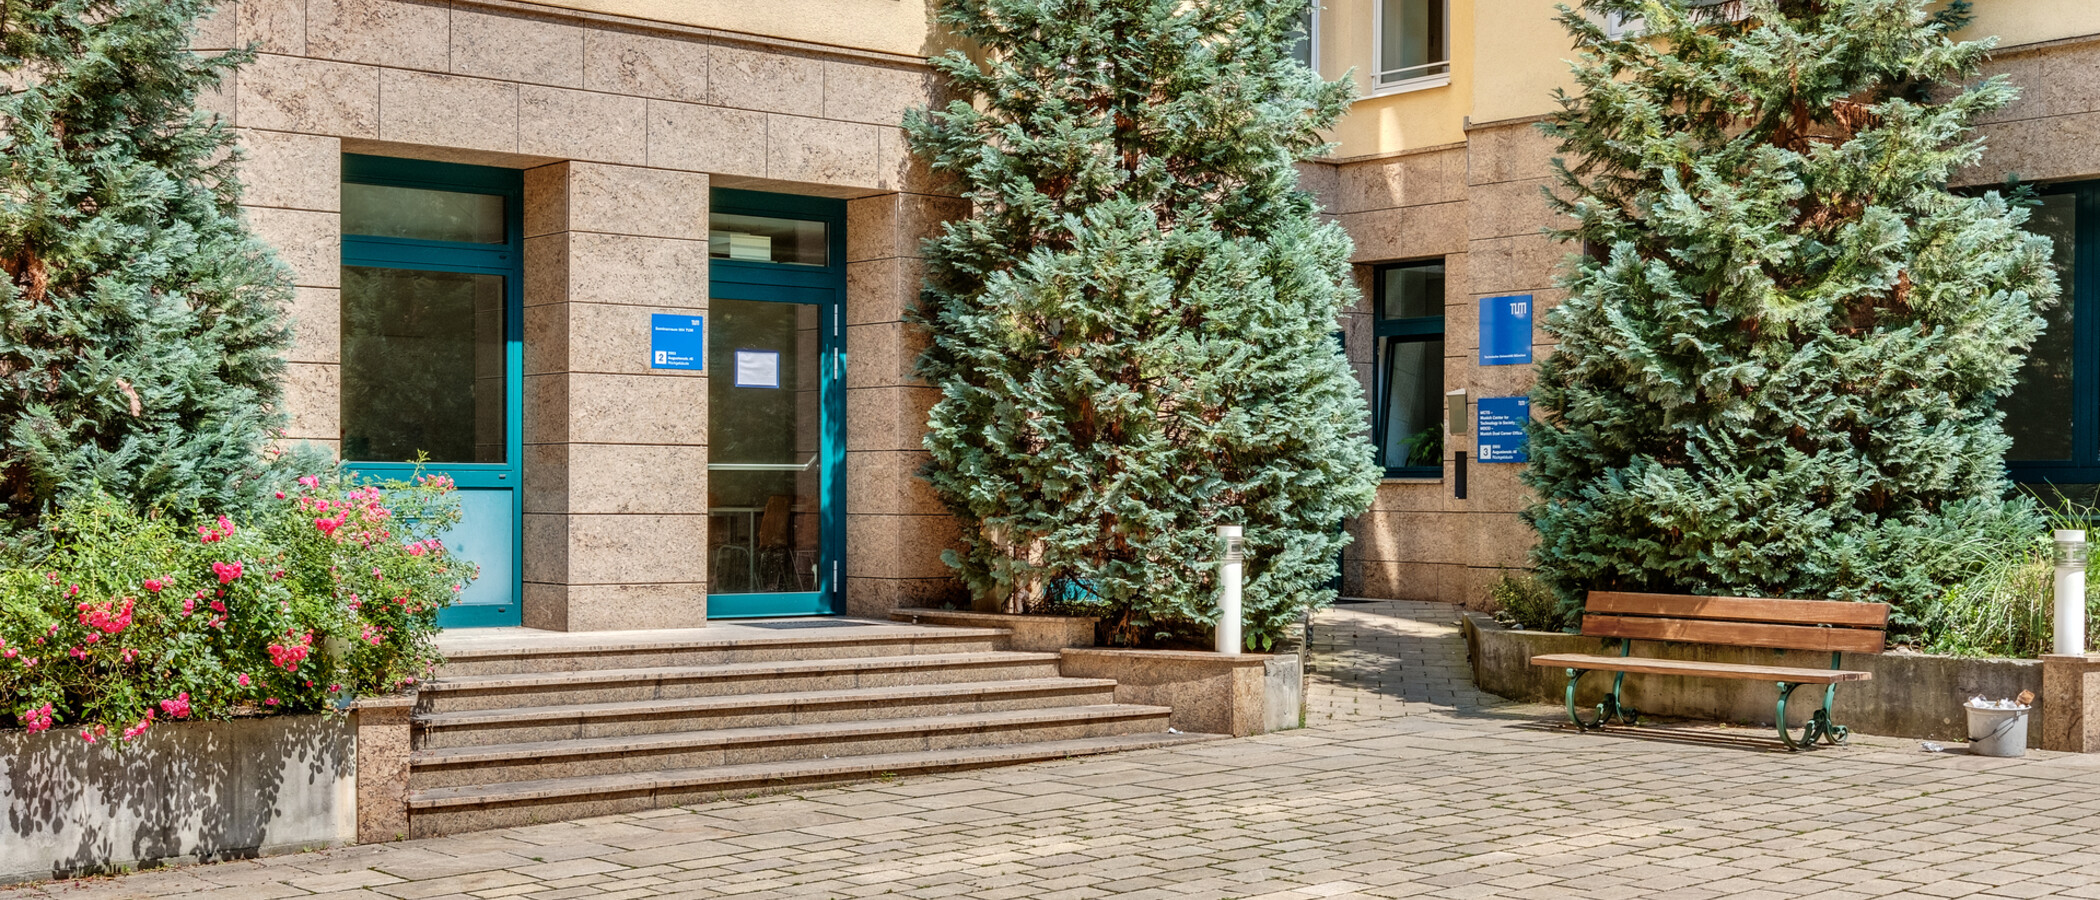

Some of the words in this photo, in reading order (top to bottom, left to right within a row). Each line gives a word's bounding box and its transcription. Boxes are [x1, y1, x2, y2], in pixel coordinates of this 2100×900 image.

[1510, 302, 1527, 315] TUM
[658, 353, 664, 362] 2
[1483, 447, 1488, 457] 3
